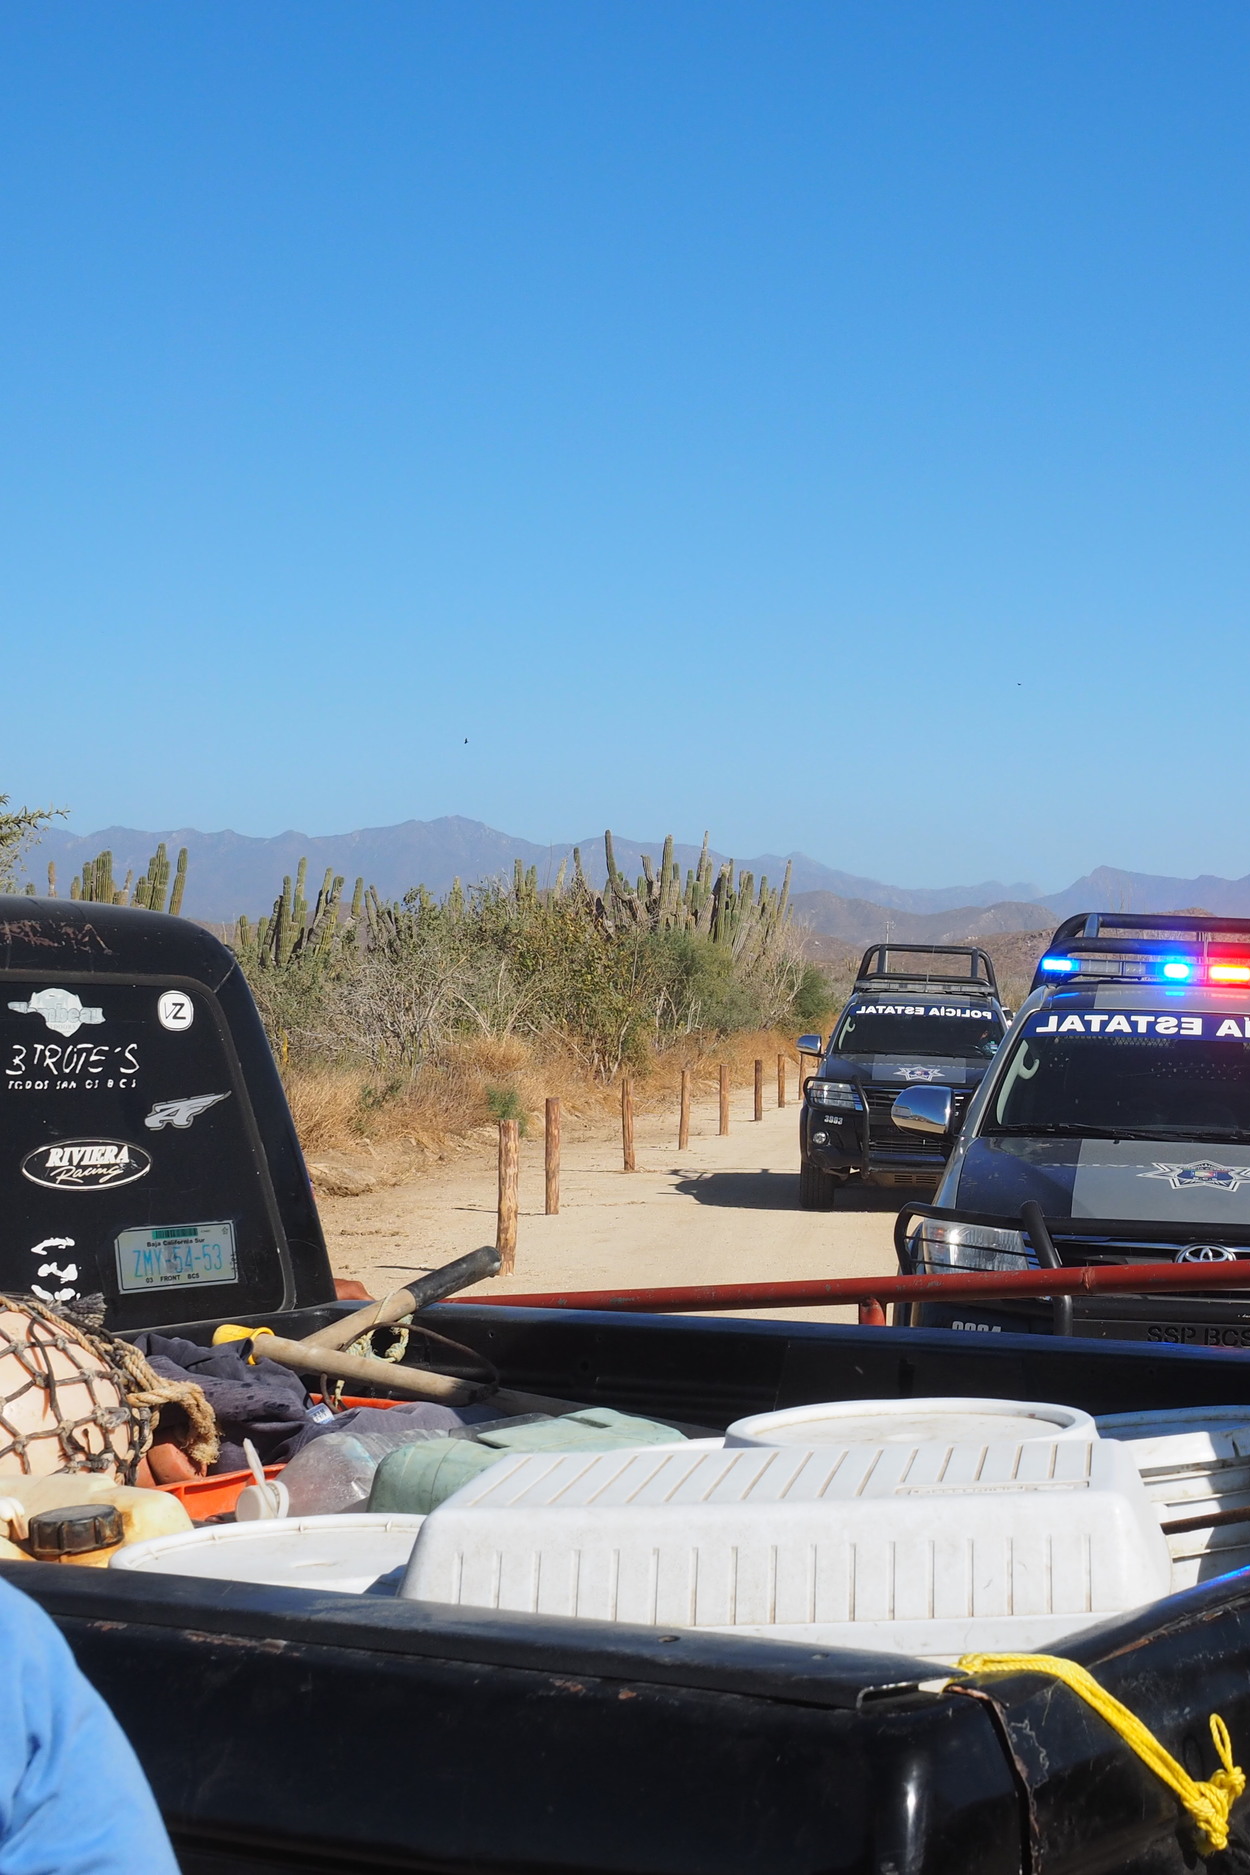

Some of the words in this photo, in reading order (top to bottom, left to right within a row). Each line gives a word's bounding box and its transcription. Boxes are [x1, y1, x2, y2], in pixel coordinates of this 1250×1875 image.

[45, 1145, 130, 1167] RIVIERA
[50, 1165, 124, 1184] Racing
[163, 1237, 193, 1246] California
[132, 1243, 223, 1278] ZMY-54-53
[1147, 1326, 1197, 1345] SSP
